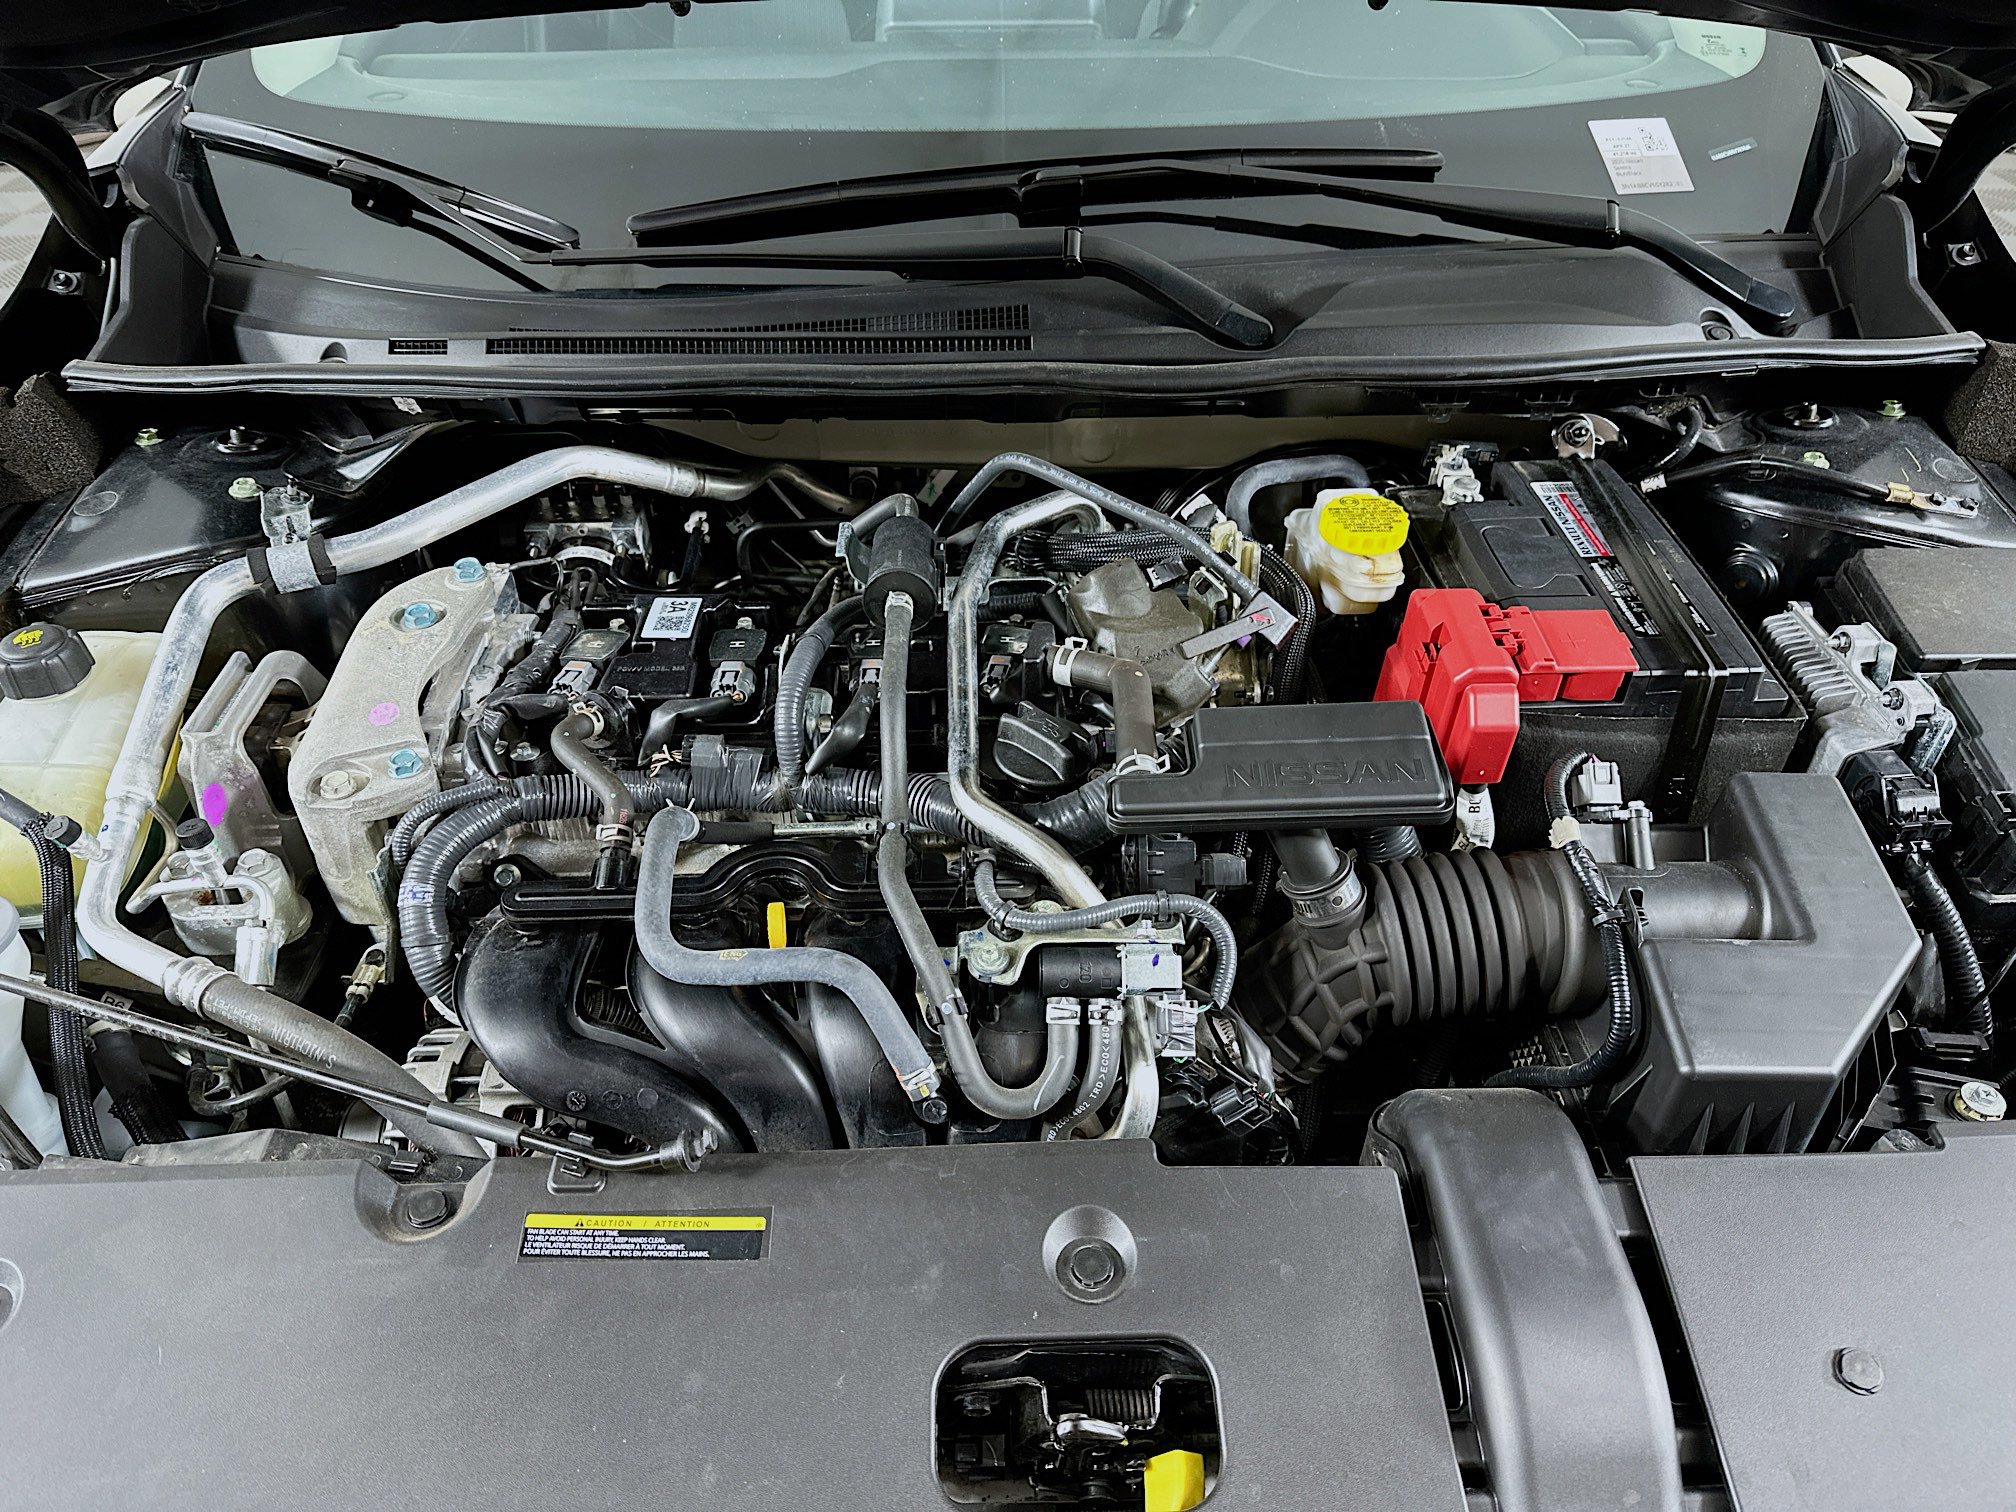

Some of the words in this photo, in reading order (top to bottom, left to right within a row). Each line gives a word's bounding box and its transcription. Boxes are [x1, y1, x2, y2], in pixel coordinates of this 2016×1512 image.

[1543, 495, 1571, 525] NISSAN
[1168, 519, 1185, 535] KINK
[1565, 526, 1592, 555] RENAULT
[667, 600, 689, 614] 3A
[1225, 758, 1428, 787] NISSAN
[1089, 1081, 1104, 1099] TRD
[603, 1242, 635, 1250] DÉMARRER
